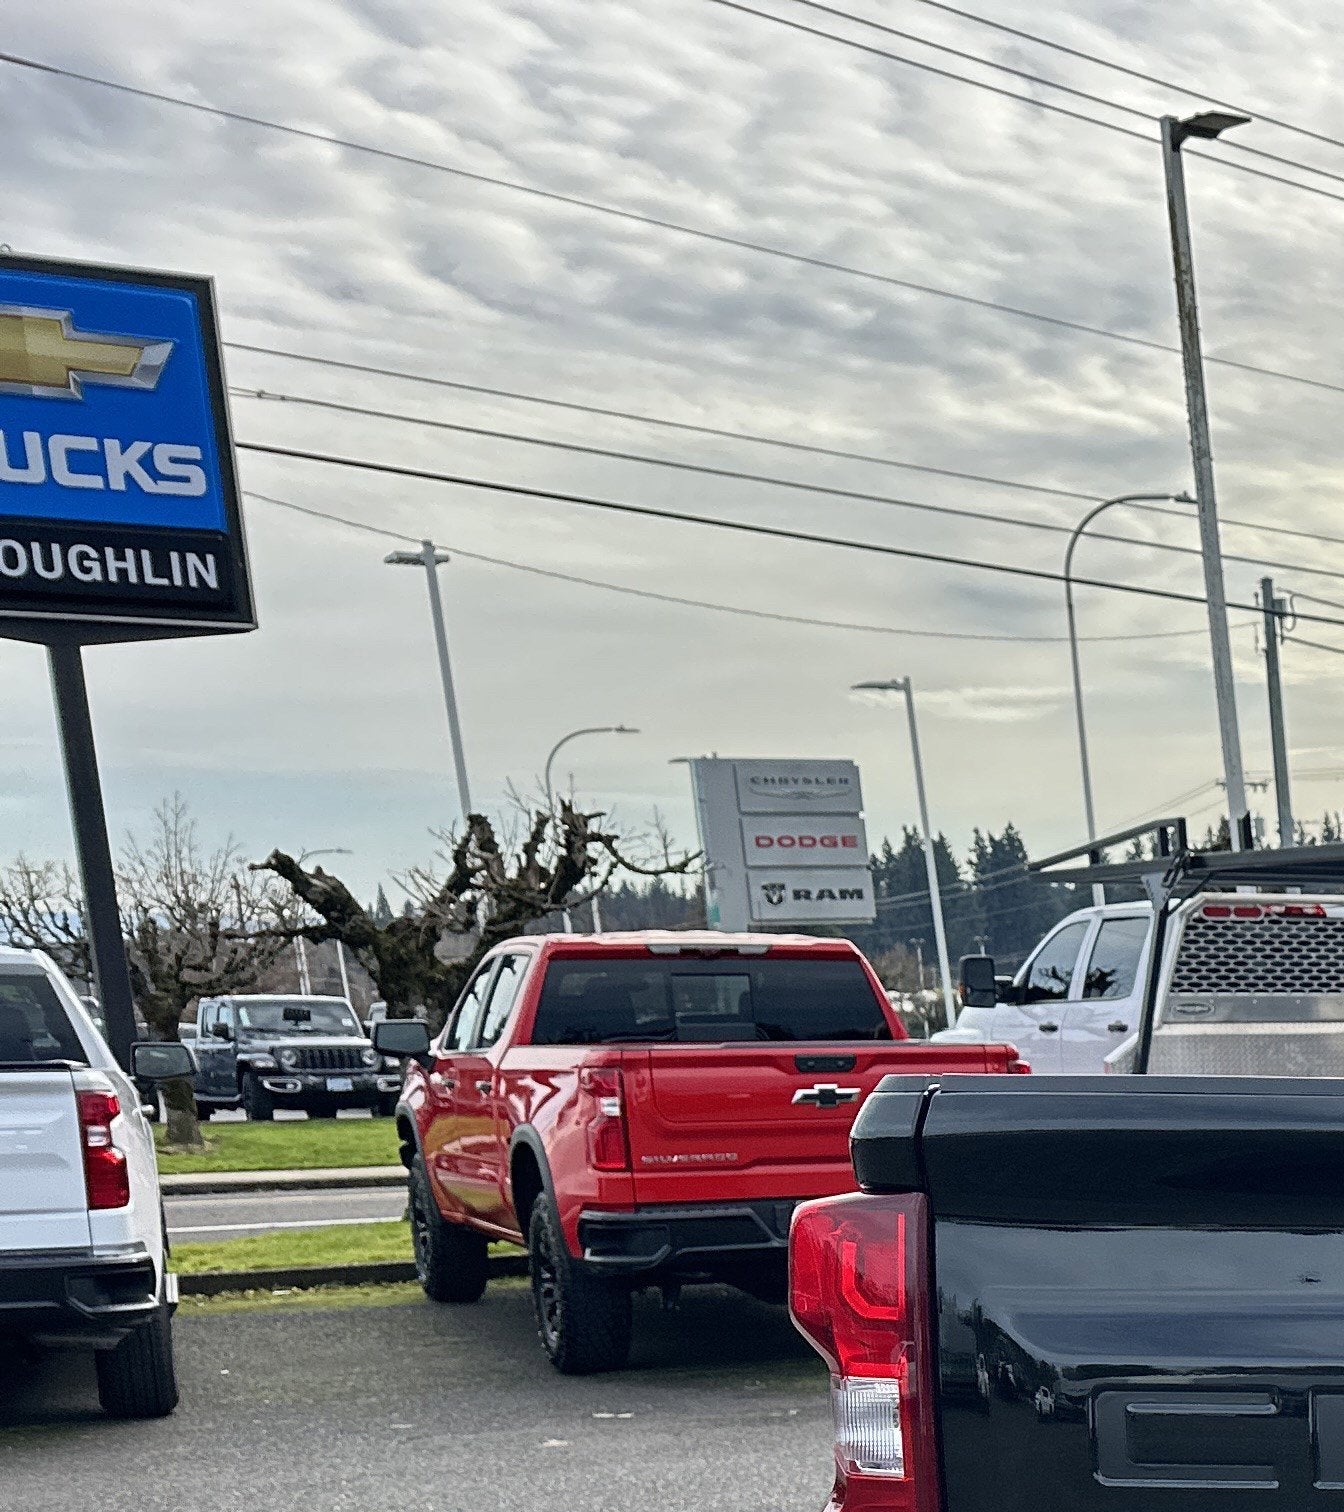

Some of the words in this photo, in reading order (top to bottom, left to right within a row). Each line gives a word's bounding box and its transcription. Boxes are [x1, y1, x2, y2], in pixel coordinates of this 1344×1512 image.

[750, 776, 849, 786] CHRYSLER
[754, 834, 859, 849] DODGE
[792, 888, 864, 901] RAM
